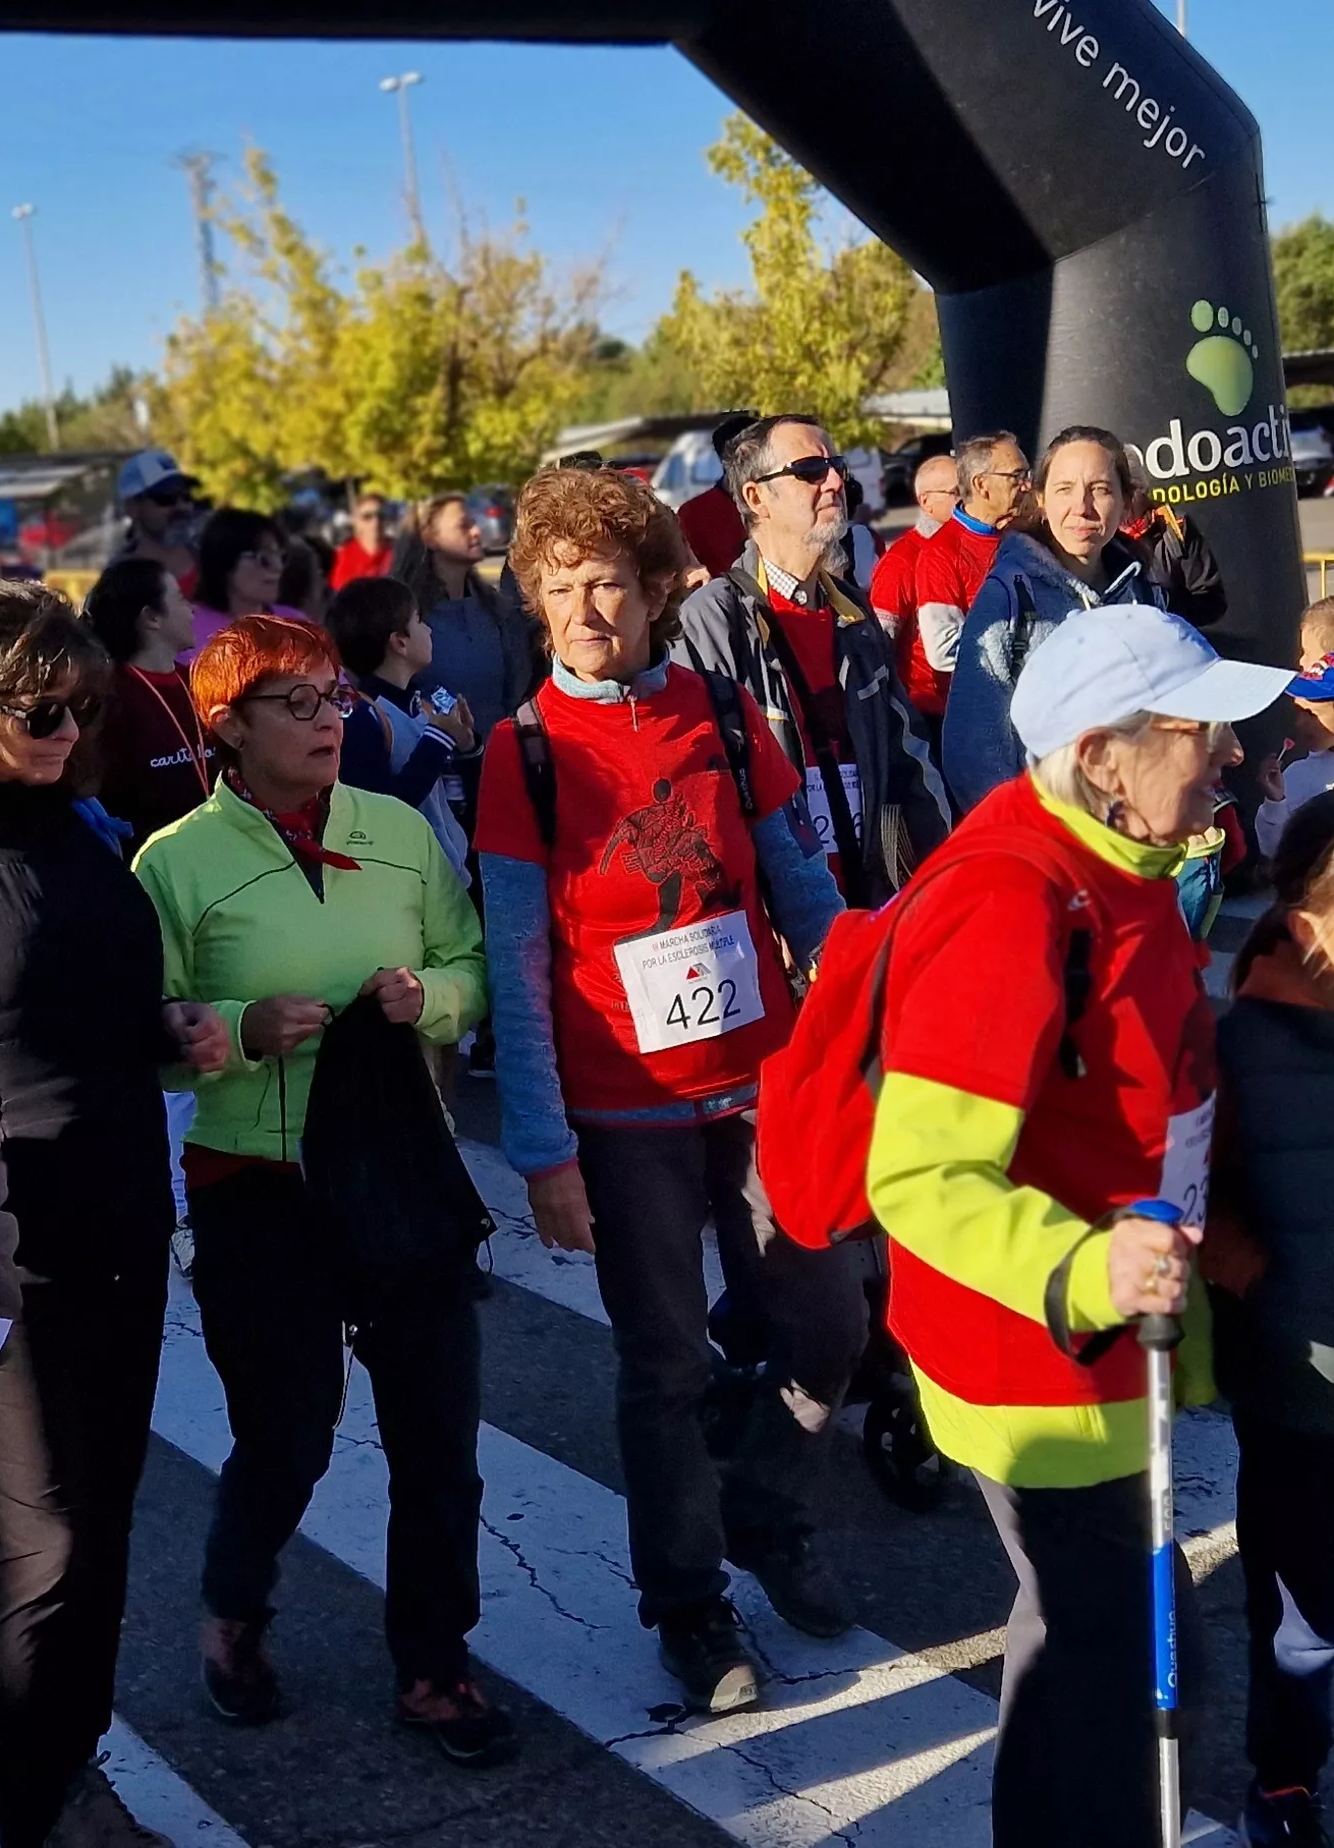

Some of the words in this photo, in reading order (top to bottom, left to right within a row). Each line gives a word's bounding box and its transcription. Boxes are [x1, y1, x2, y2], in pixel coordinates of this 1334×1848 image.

[1033, 0, 1099, 67] vive
[1102, 62, 1206, 169] mejor
[1123, 404, 1293, 479] doacti
[1244, 473, 1254, 491] Y
[642, 957, 657, 970] POR
[658, 954, 668, 966] LA
[667, 943, 709, 963] ESCLEROSIS
[659, 935, 689, 950] MARCHA
[689, 925, 722, 942] SOLIDARIA
[666, 978, 741, 1030] 422
